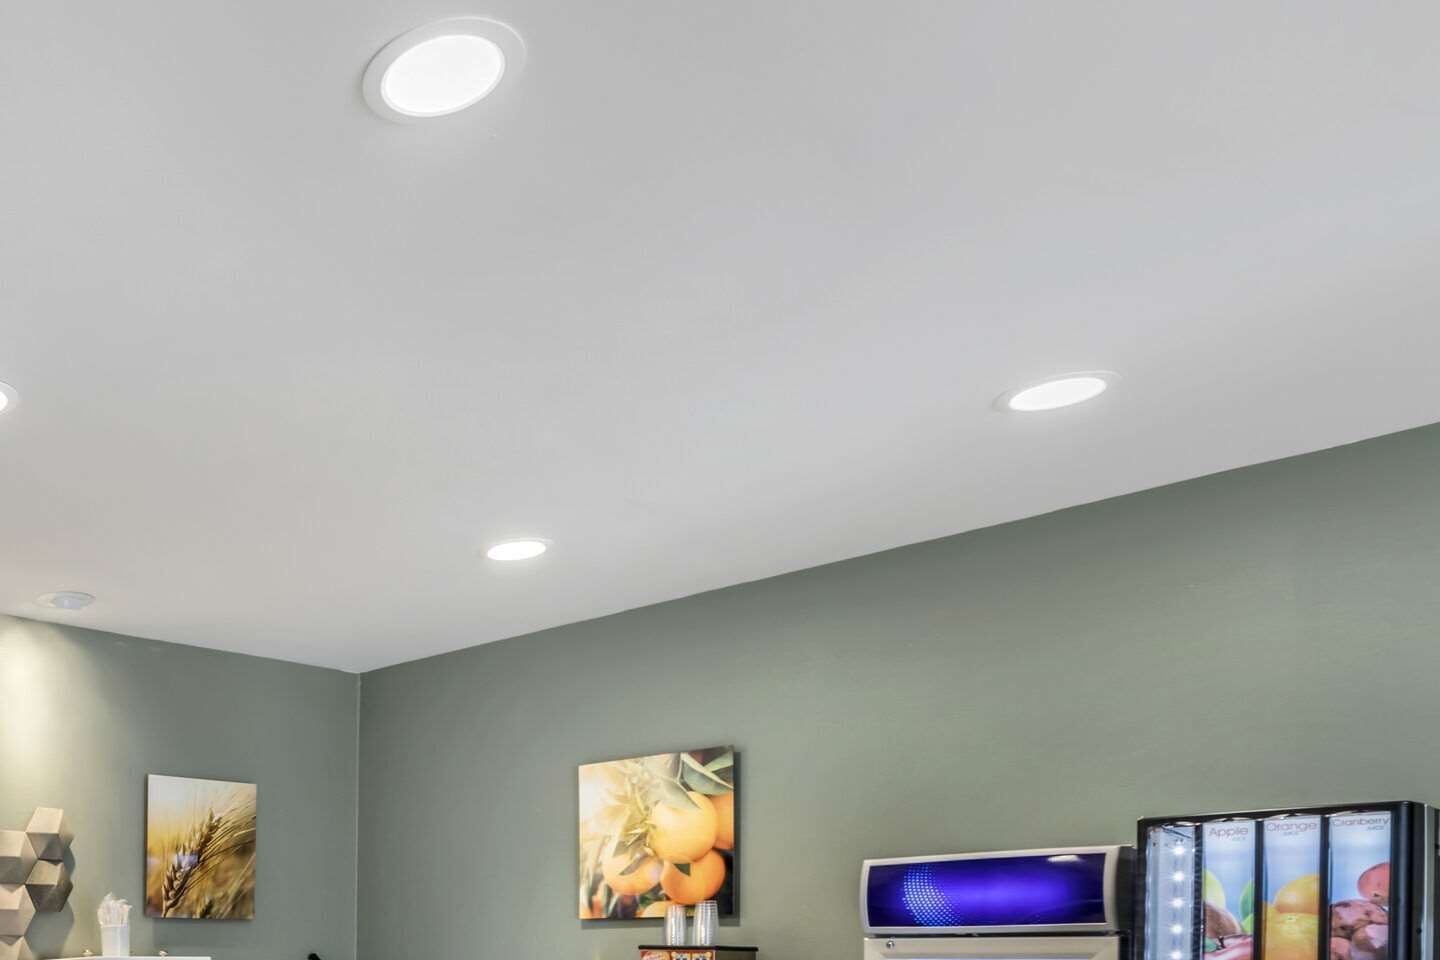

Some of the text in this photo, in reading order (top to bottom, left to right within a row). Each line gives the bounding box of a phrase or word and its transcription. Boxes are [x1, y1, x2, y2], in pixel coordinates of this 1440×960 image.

[1266, 821, 1318, 832] Orange
[1332, 817, 1390, 827] Cranberry
[1210, 826, 1249, 837] Apple
